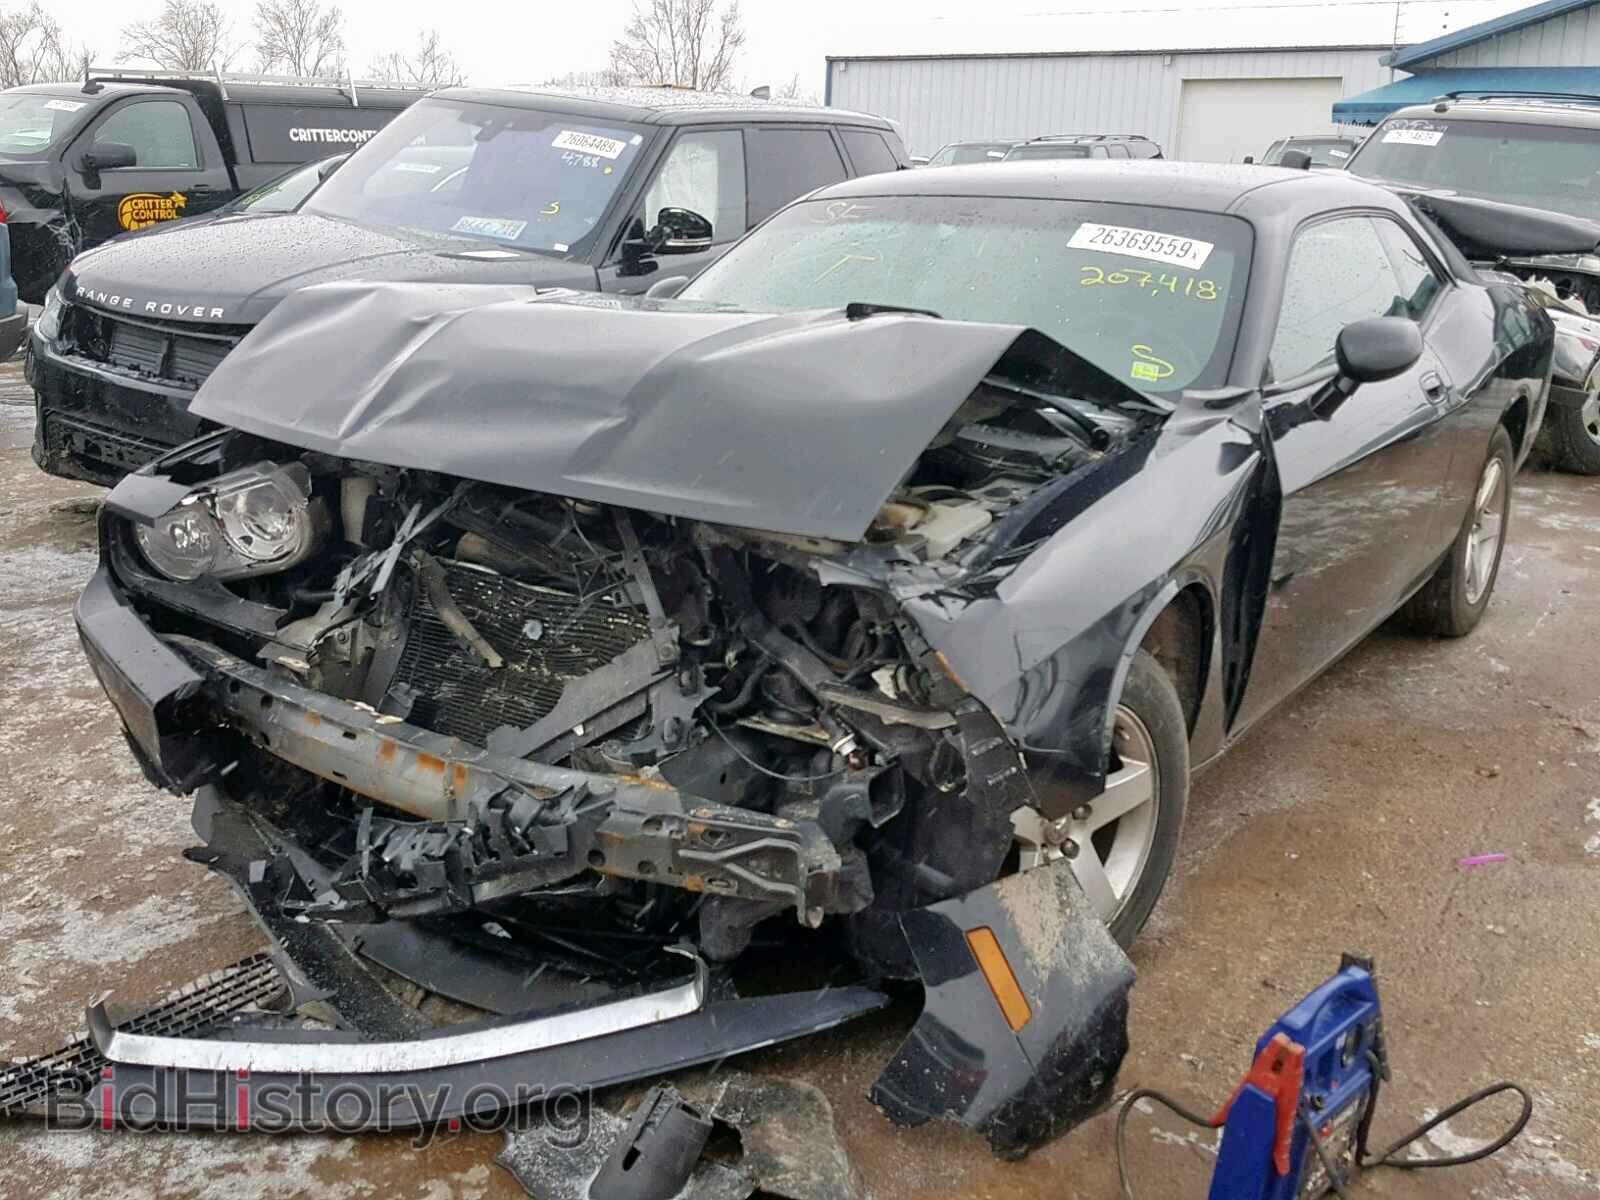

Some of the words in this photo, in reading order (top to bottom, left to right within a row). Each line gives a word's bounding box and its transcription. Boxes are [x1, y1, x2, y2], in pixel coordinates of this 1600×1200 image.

[289, 127, 377, 143] CRITTERCONT
[131, 199, 173, 209] CRITTER
[132, 209, 177, 220] CONTROL
[1089, 227, 1193, 258] 26369559
[1080, 266, 1217, 300] 207,418
[75, 286, 133, 309] RANGE
[144, 301, 225, 319] ROVER
